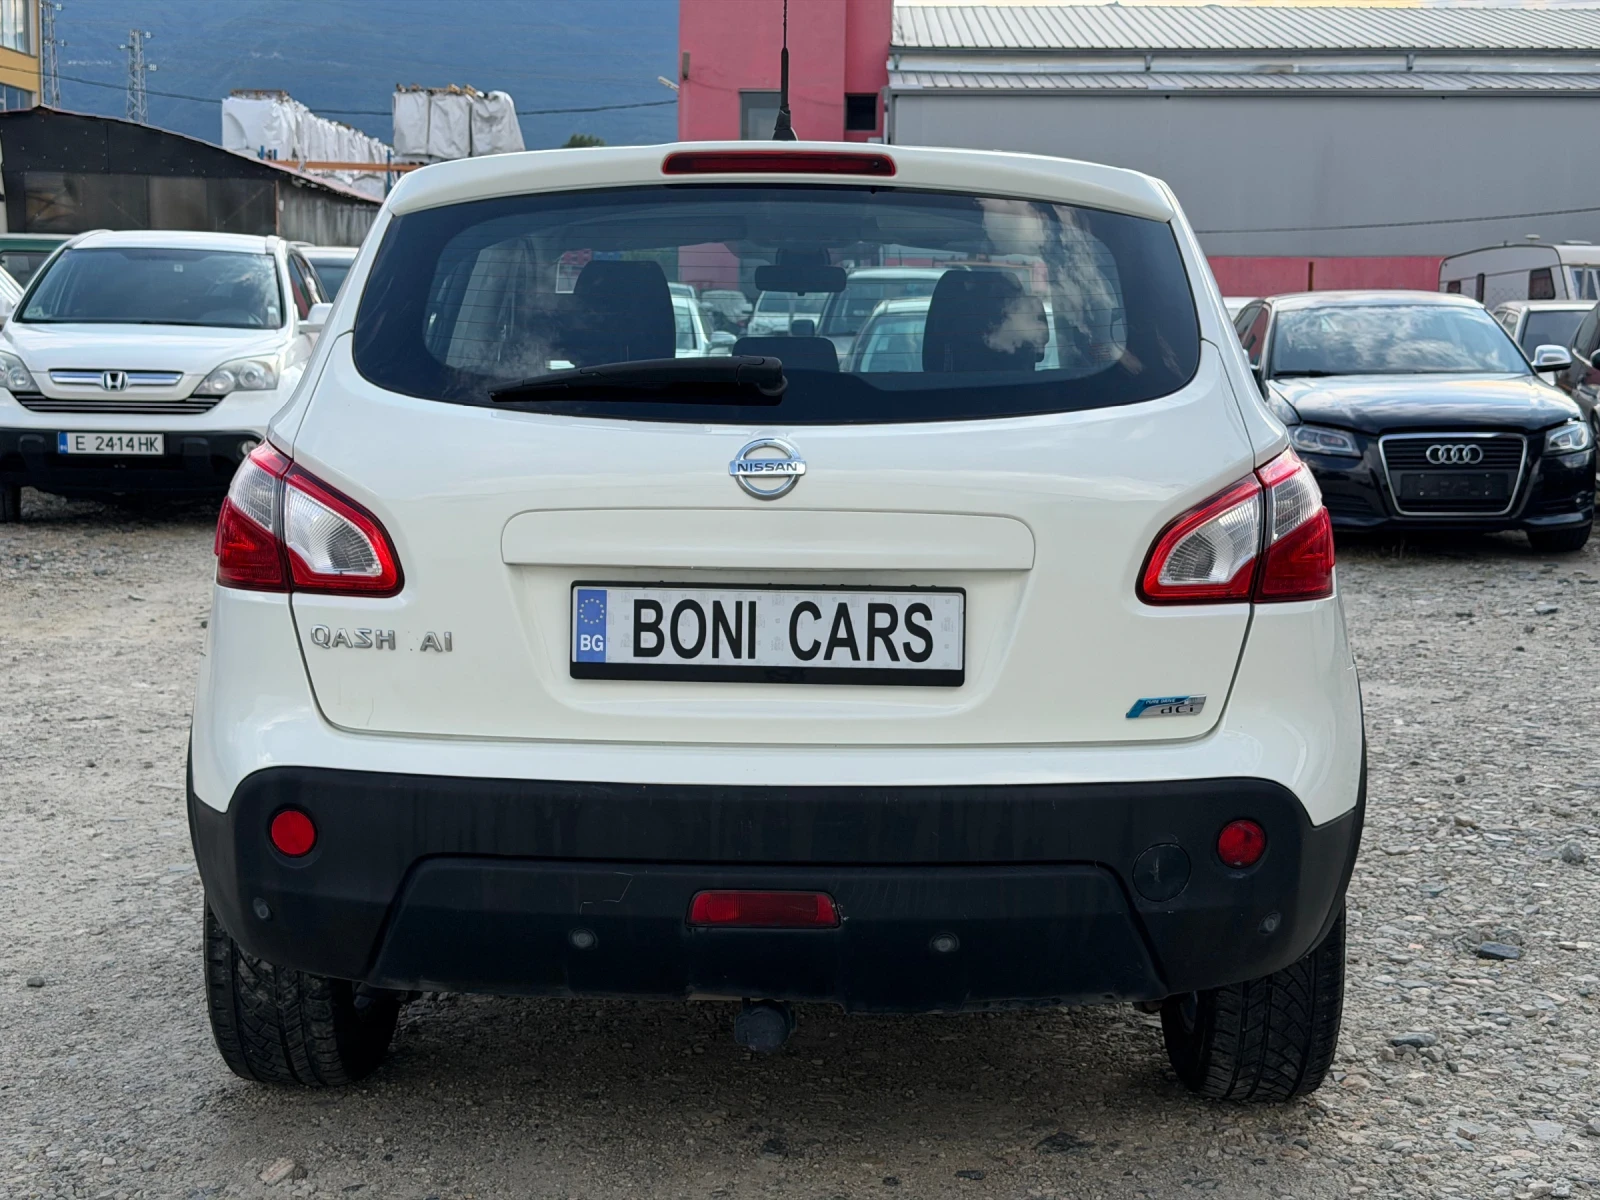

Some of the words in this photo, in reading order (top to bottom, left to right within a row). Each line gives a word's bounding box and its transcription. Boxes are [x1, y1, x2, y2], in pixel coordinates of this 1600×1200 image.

[737, 462, 797, 472] NISSAN
[310, 624, 396, 650] QASH
[420, 631, 453, 652] AI
[633, 598, 756, 660] BONI
[788, 600, 934, 663] CARS
[580, 634, 604, 652] BG
